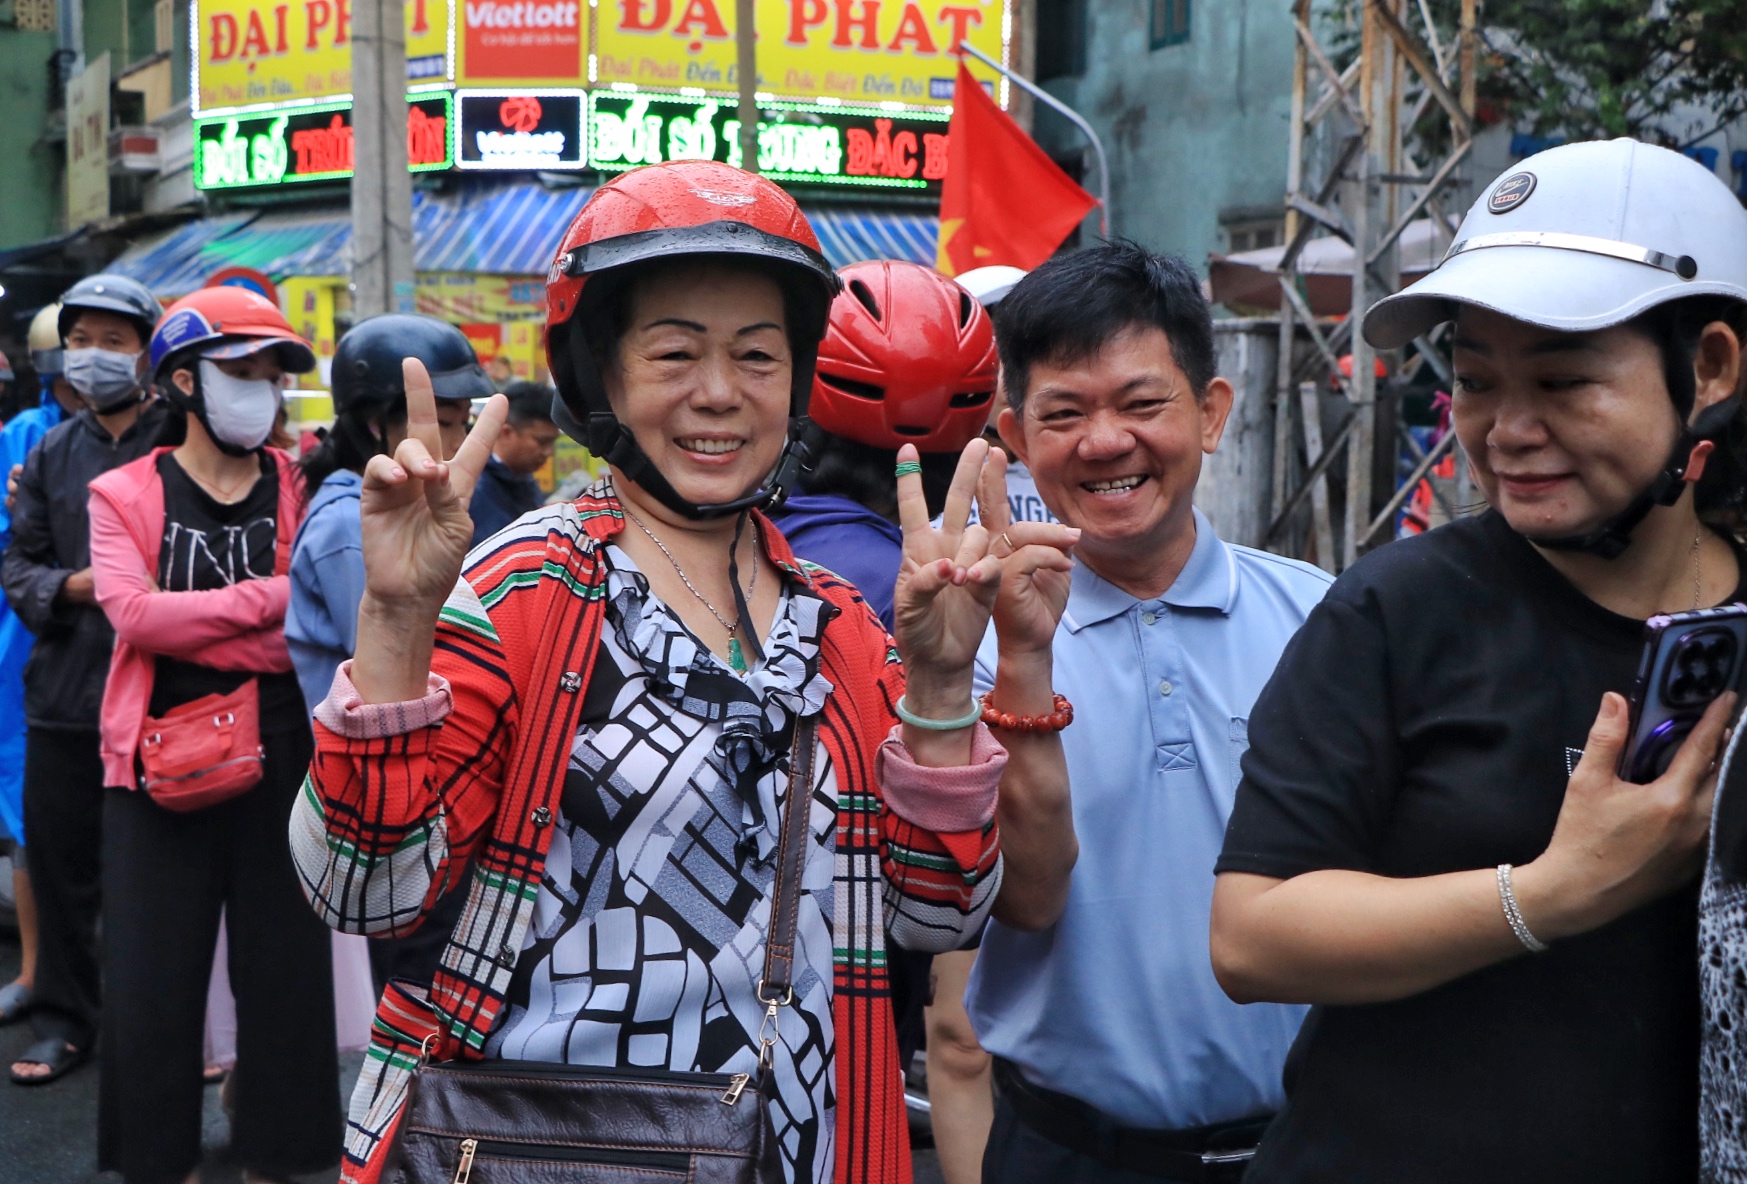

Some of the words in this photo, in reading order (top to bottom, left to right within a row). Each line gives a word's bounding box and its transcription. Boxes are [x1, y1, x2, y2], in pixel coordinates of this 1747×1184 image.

[209, 5, 290, 72] ĐẠI
[465, 1, 578, 28] Vietlott
[617, 0, 758, 52] ĐẠ
